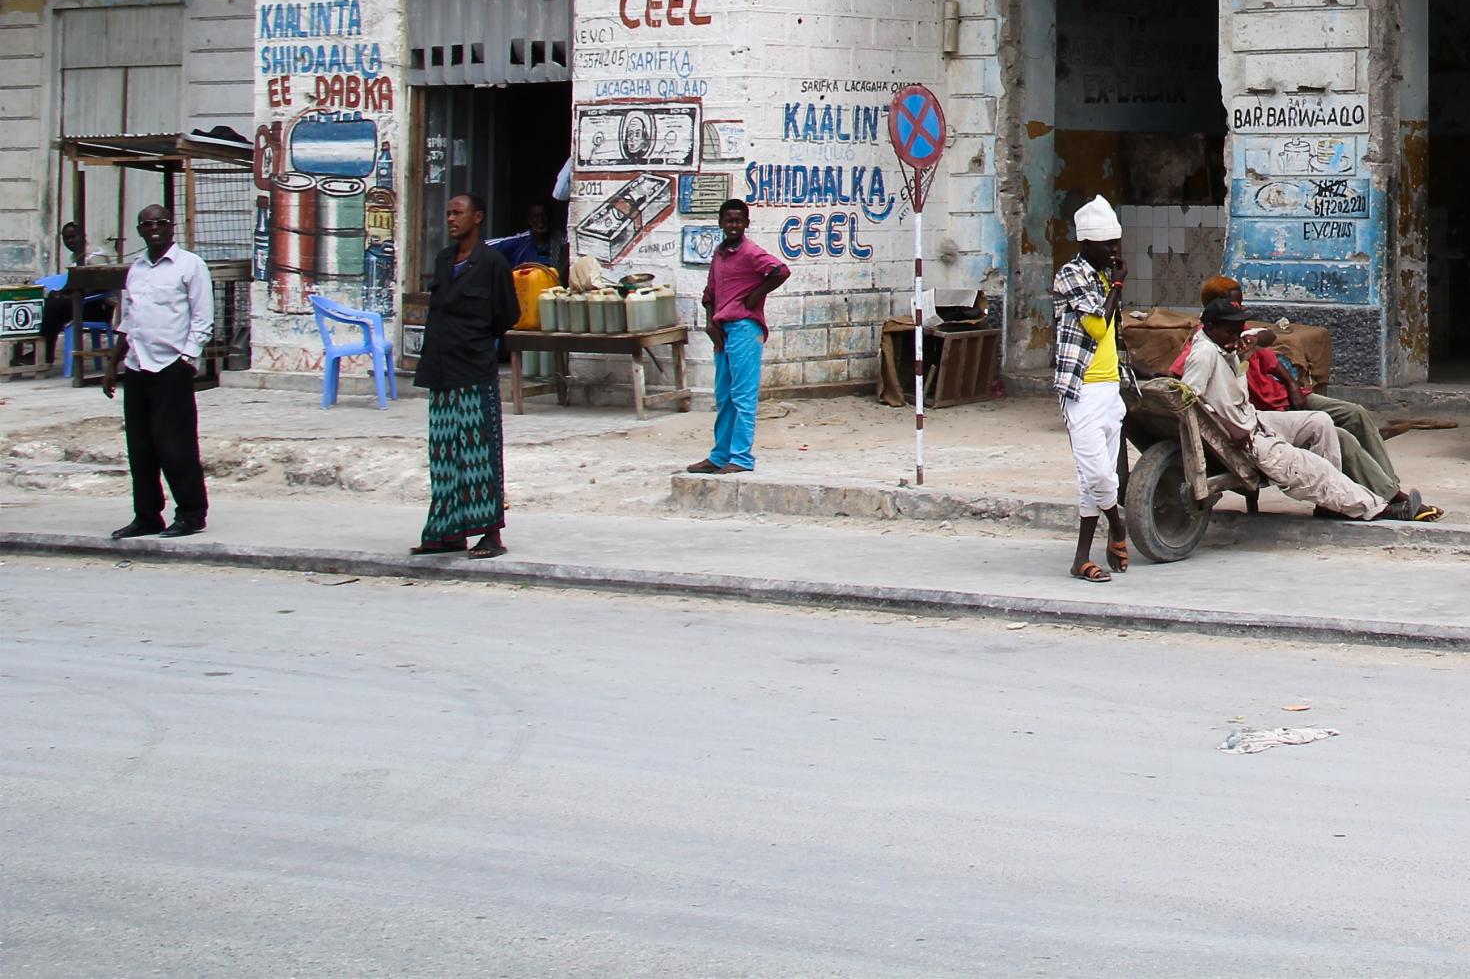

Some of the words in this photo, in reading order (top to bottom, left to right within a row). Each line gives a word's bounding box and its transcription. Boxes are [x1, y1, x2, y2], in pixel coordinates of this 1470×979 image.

[260, 0, 362, 39] KAALINTA
[260, 43, 383, 80] SHIIDAALKA
[268, 75, 292, 108] EE
[315, 75, 394, 110] DABKA
[596, 79, 651, 97] LACAGAHA
[657, 79, 708, 97] QALAAD
[800, 80, 839, 93] SARIFKA
[844, 80, 888, 93] LACAGAHA
[783, 102, 889, 144] KAALIN
[578, 181, 603, 196] 2011
[745, 161, 895, 224] SHIIDAALKA
[779, 212, 873, 260] CEEL
